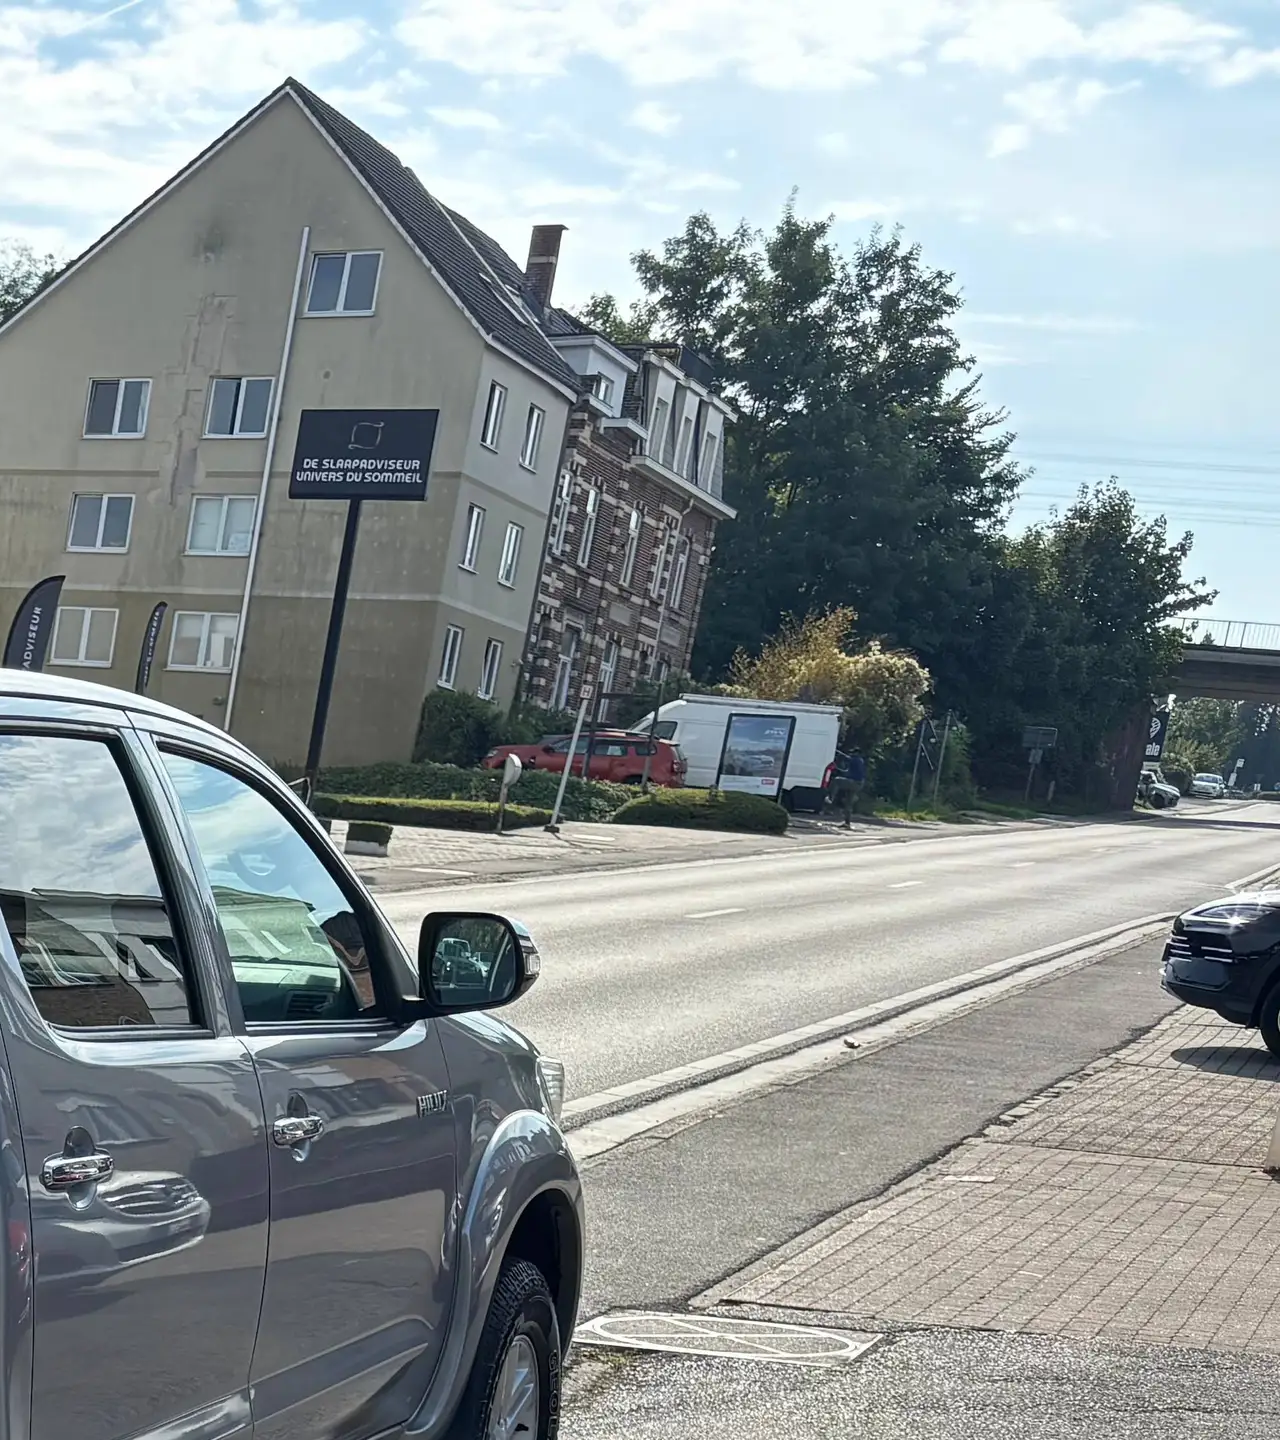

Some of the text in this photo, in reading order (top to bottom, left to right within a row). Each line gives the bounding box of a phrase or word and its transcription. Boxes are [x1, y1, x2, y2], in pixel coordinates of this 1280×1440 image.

[303, 458, 421, 471] DE SLAAPADVISEUR
[296, 471, 423, 483] UNIVERS DU SOMMEIL
[21, 606, 43, 670] ADVISEUR
